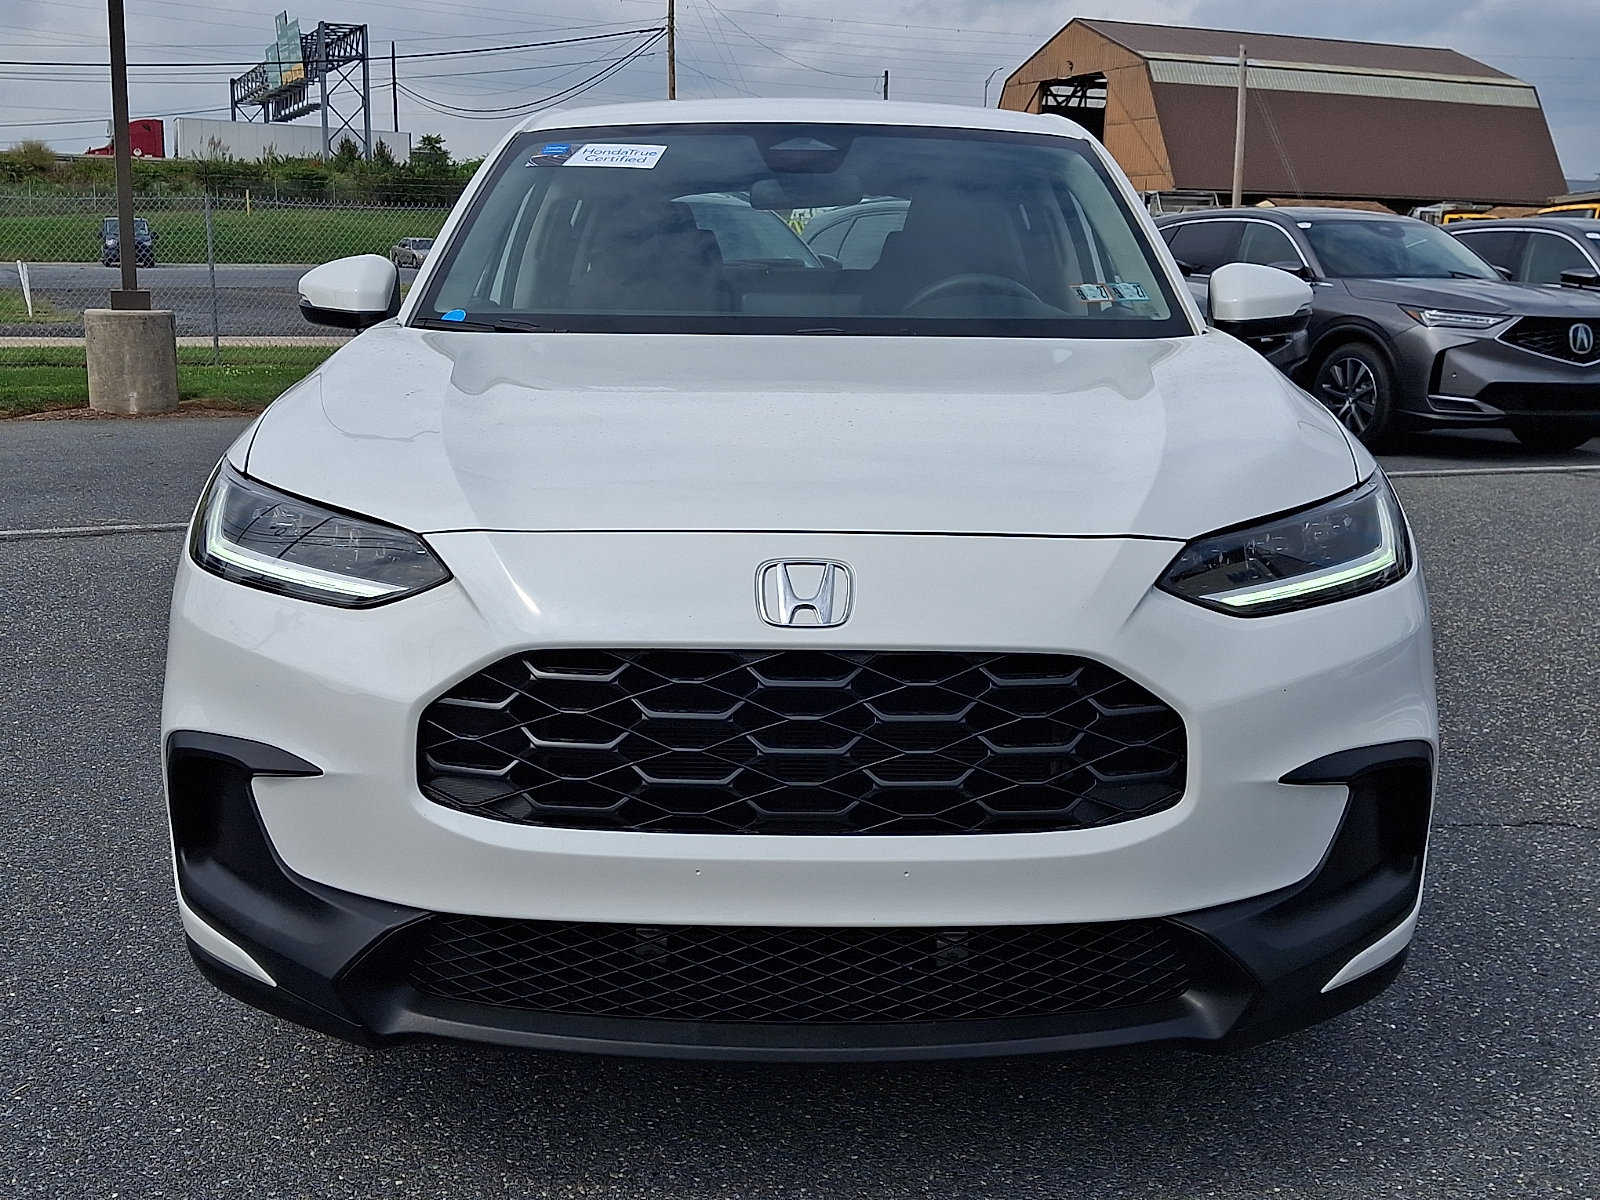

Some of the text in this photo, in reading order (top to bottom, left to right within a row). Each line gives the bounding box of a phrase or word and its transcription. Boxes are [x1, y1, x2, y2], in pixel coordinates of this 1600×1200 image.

[582, 148, 658, 157] HondaTrue
[584, 155, 647, 163] Certified
[1096, 285, 1110, 300] 27
[1133, 284, 1146, 299] 27
